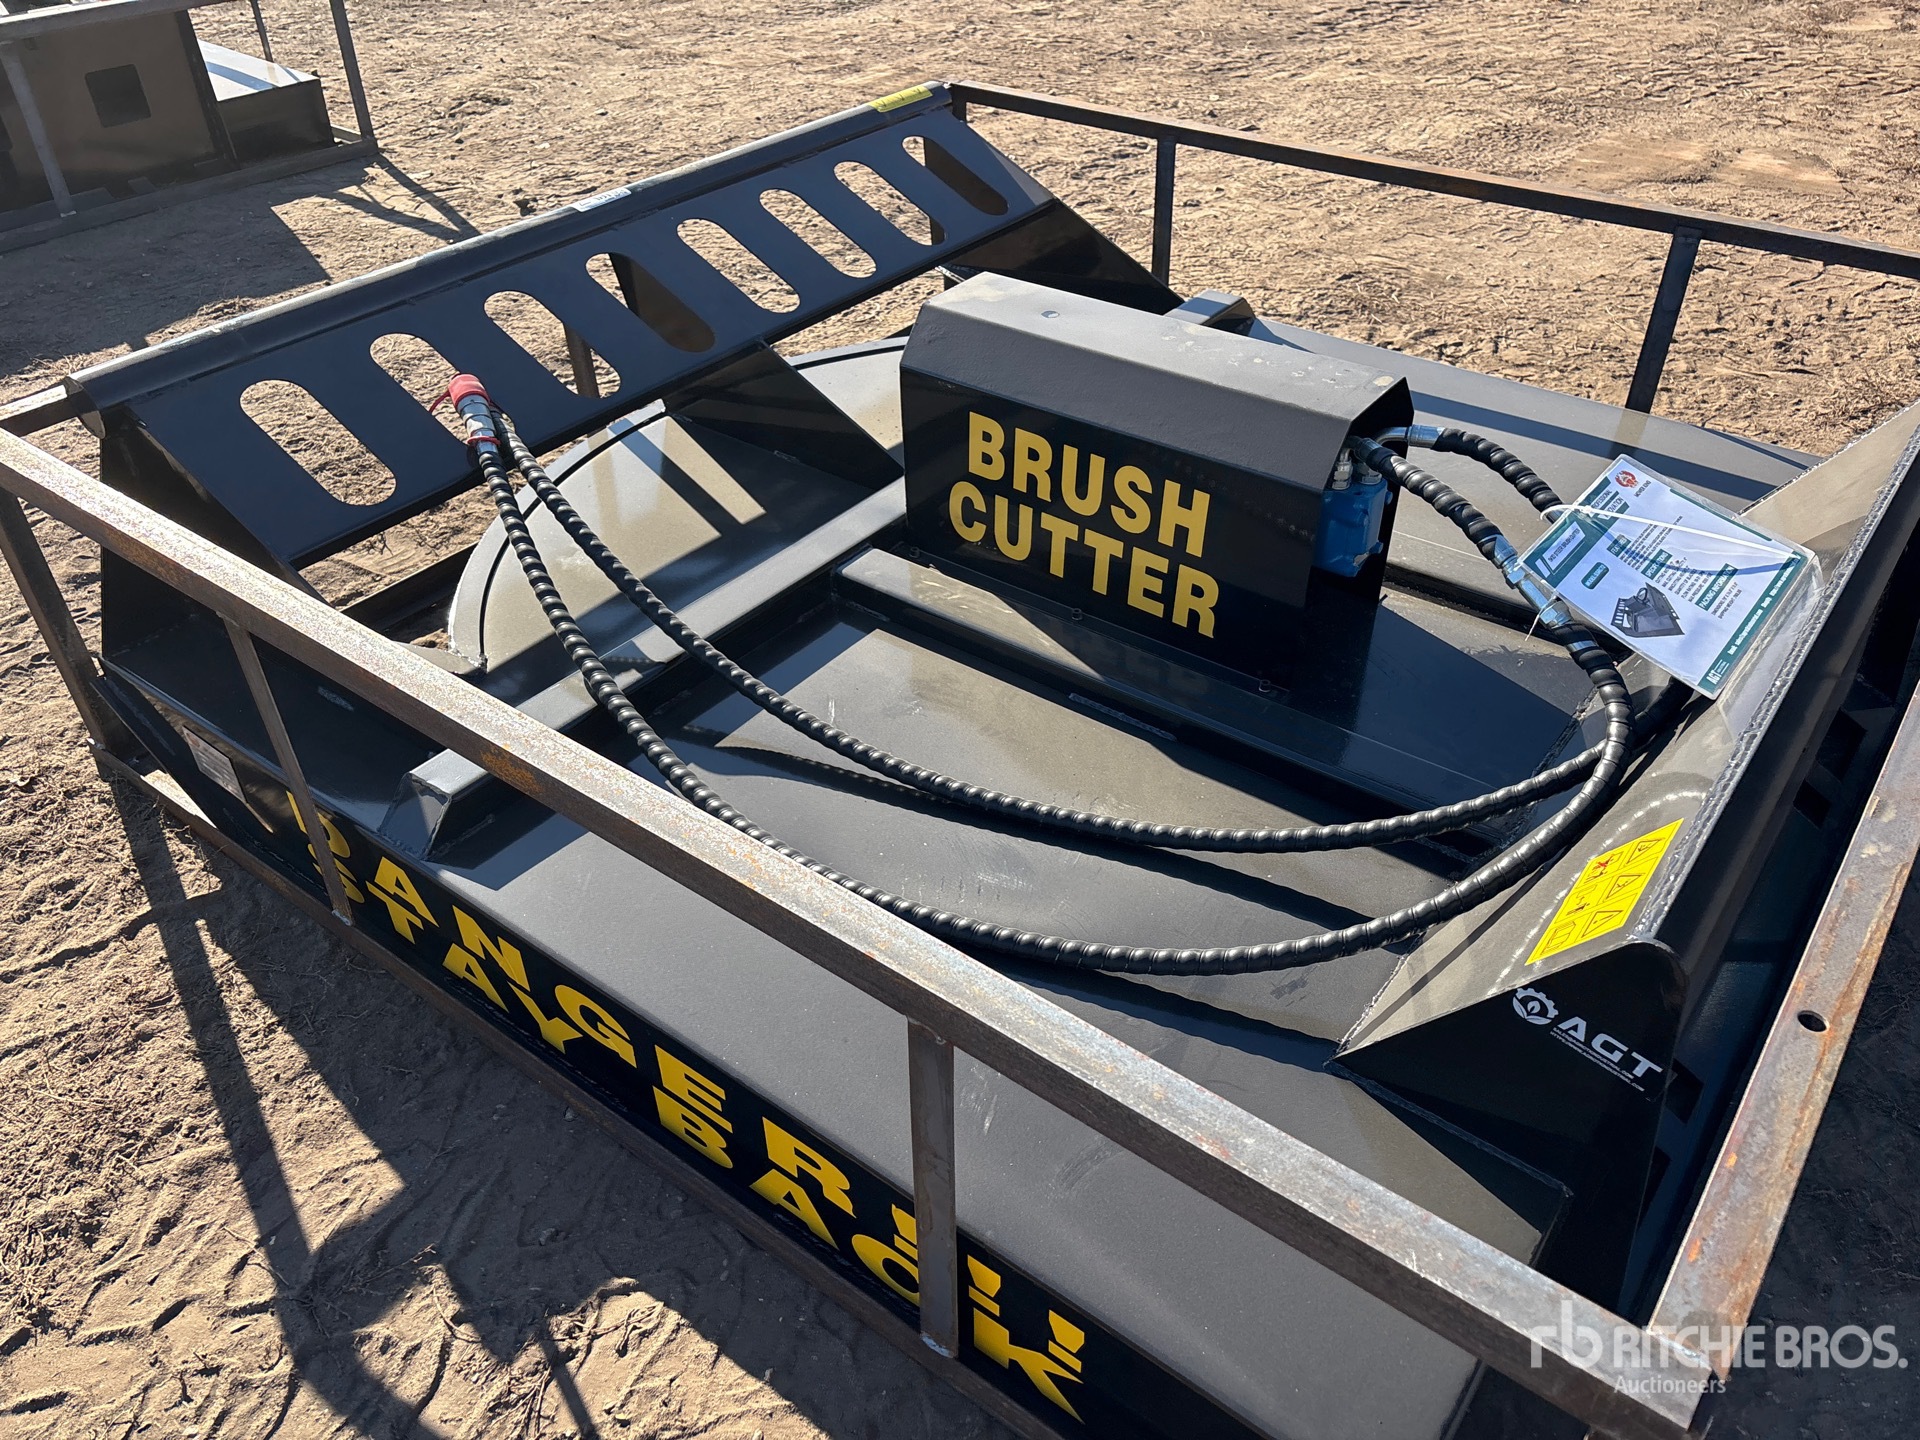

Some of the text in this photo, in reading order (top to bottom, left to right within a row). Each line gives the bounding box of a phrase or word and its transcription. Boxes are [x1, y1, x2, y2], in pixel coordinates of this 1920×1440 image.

[968, 411, 1211, 558] BRUSH
[949, 481, 1219, 639] CUTTER
[1705, 668, 1722, 685] AGT
[1557, 1016, 1663, 1078] AGT
